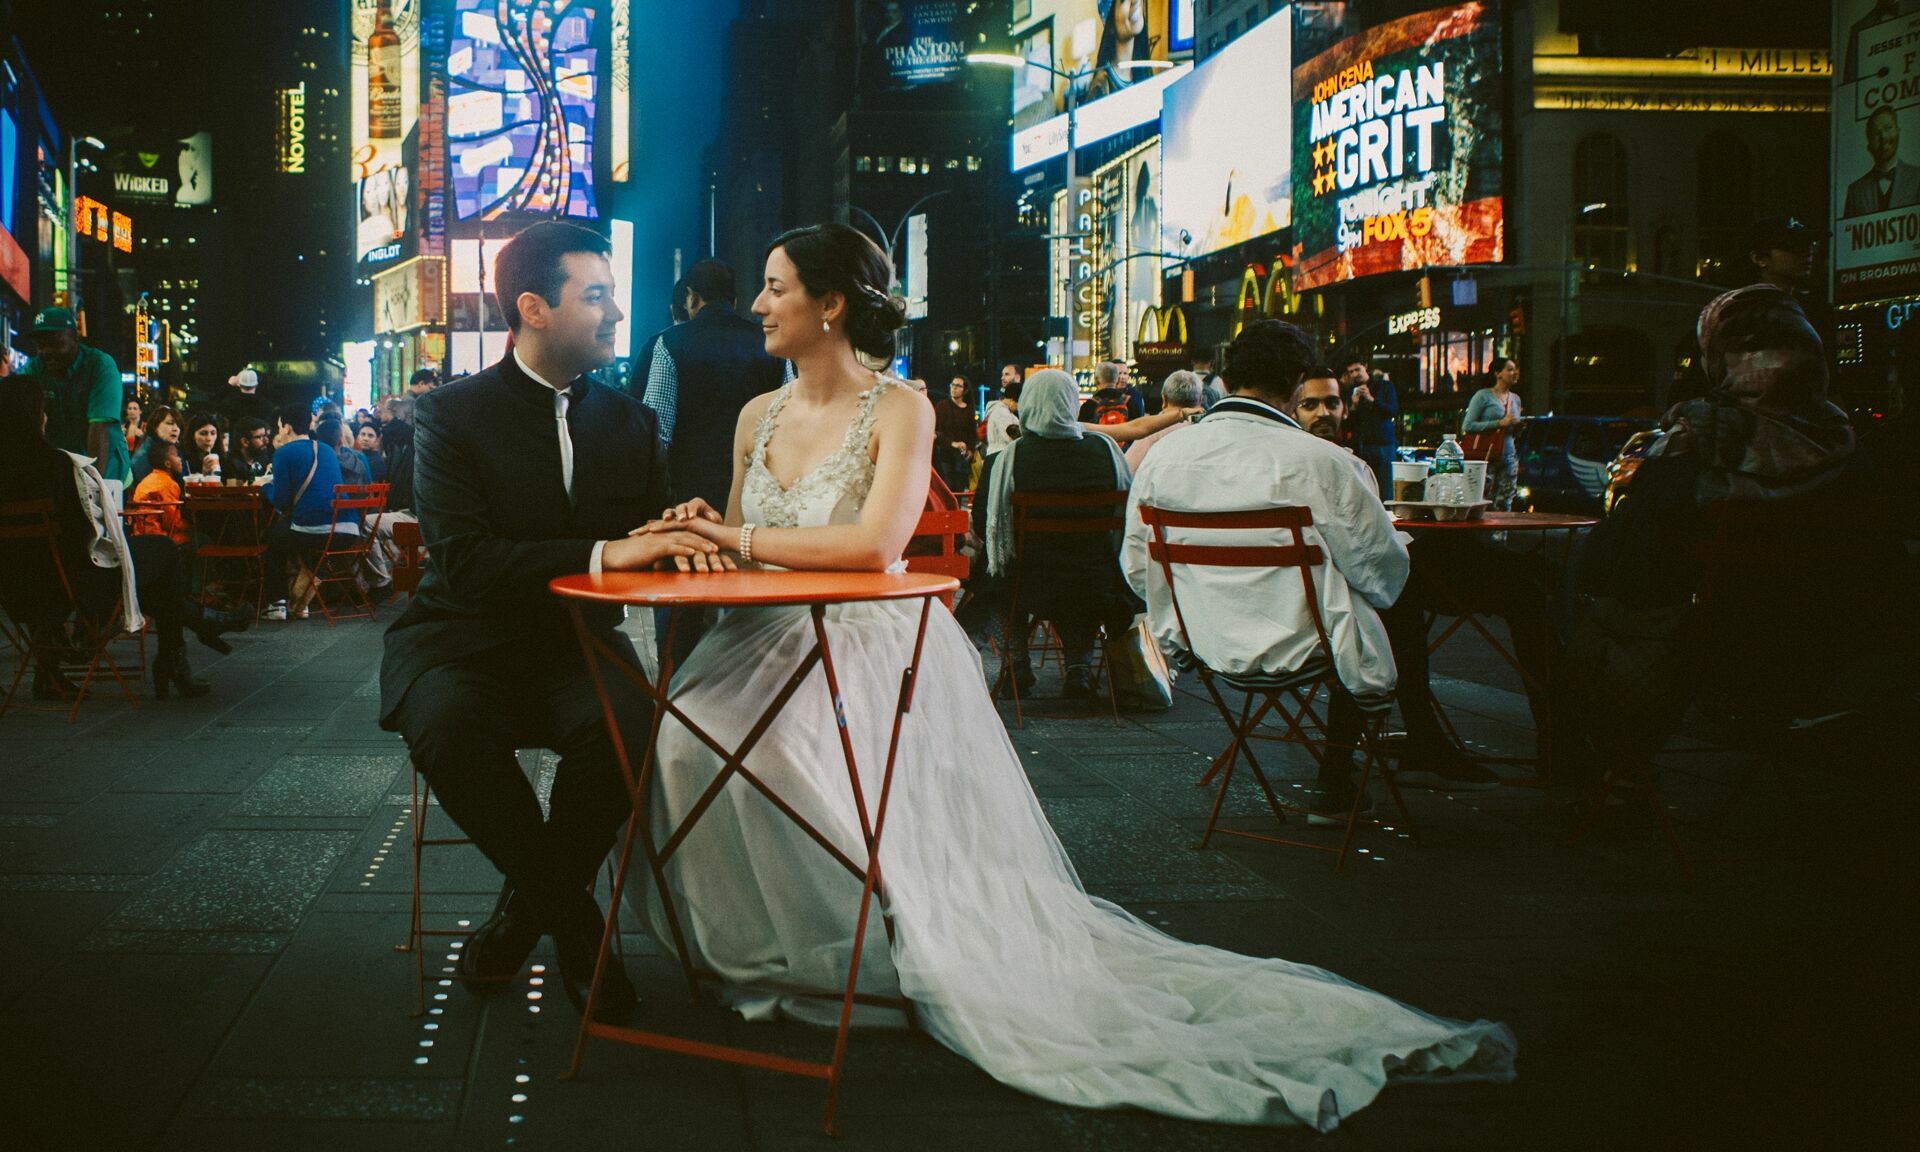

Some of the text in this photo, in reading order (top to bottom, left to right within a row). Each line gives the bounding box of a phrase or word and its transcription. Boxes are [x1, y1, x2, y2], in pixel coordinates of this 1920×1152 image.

[885, 41, 965, 60] PHANTOM
[1868, 36, 1903, 57] JESSE
[1312, 59, 1374, 106] JOHN CENA
[1310, 61, 1445, 145] AMERICAN
[287, 81, 305, 173] NOVOTEL
[1336, 105, 1446, 191] GRIT
[1339, 176, 1432, 222] TONIGHT
[1364, 209, 1409, 246] FOX
[1410, 206, 1433, 237] 5
[1844, 212, 1920, 251] "NONSTO
[368, 244, 401, 263] INGLOT
[1079, 188, 1091, 328] PALACE
[1841, 271, 1858, 284] ON
[1388, 306, 1440, 335] EXPRESS
